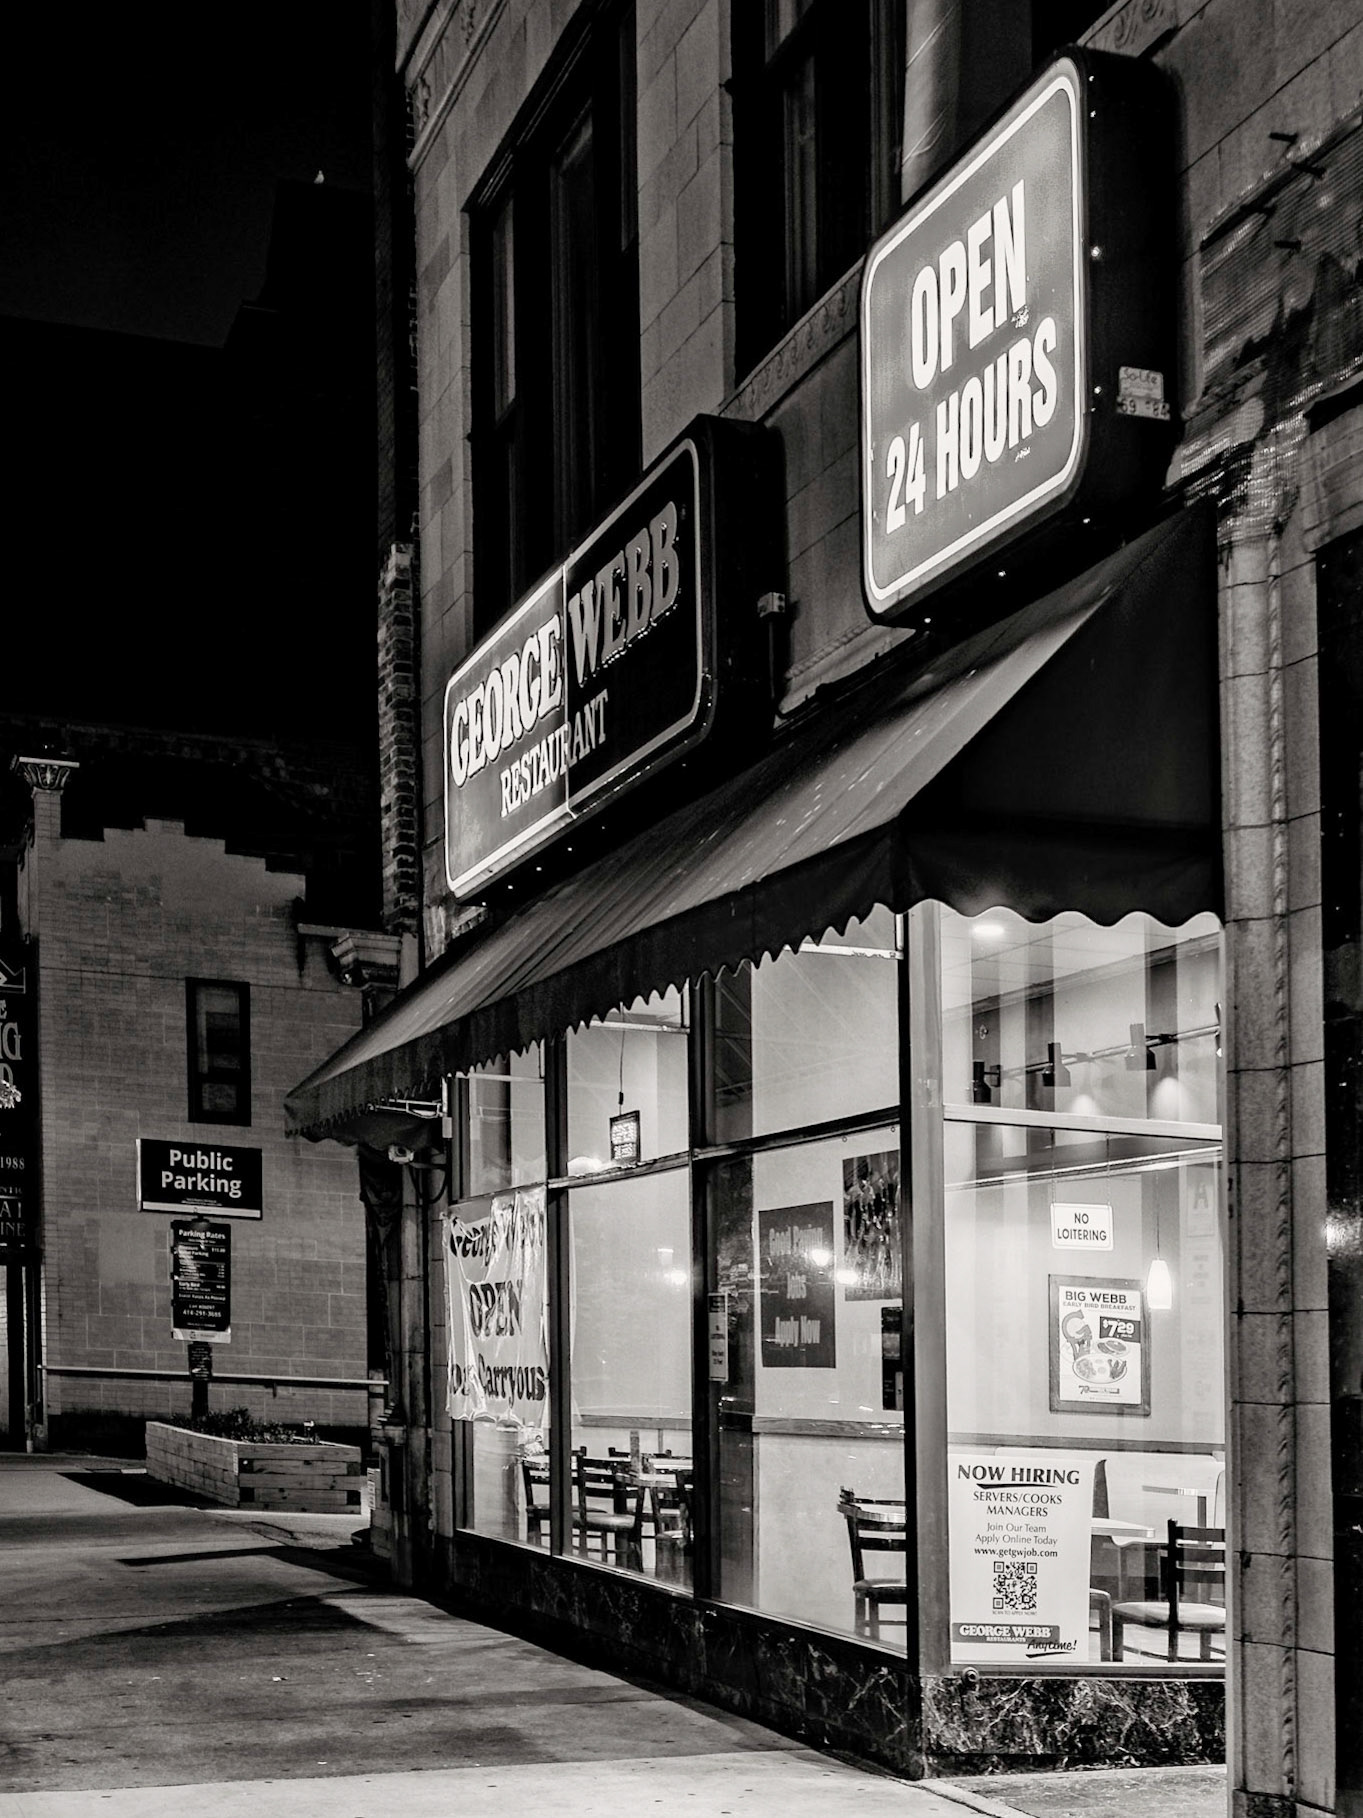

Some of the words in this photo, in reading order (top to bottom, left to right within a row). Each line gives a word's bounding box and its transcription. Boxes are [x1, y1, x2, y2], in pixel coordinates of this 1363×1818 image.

[911, 179, 1026, 390] OPEN
[885, 422, 927, 535] 24
[935, 317, 1058, 501] HOURS
[450, 614, 563, 788] GEORGE
[567, 501, 680, 688] WEBB
[500, 689, 608, 818] RESTAURANT
[0, 1156, 25, 1170] 1988
[169, 1149, 233, 1171] Public
[161, 1171, 242, 1198] Parking
[1074, 1213, 1090, 1225] NO
[178, 1229, 205, 1240] Parking
[206, 1231, 226, 1240] Rates
[1057, 1228, 1108, 1241] LOITERING
[1065, 1291, 1086, 1302] BIG
[1090, 1292, 1127, 1304] WEBB
[469, 1279, 524, 1338] OPEN
[957, 1464, 1005, 1481] NOW
[1011, 1467, 1080, 1485] HIRING
[972, 1491, 1063, 1505] SERVERS/COOKS
[986, 1505, 1049, 1517] MANAGERS
[986, 1522, 1004, 1532] Join
[1006, 1523, 1023, 1532] Our
[1024, 1524, 1047, 1533] Team
[975, 1533, 1000, 1545] Apply
[1002, 1534, 1032, 1544] Online
[1033, 1535, 1058, 1547] Today
[974, 1547, 1058, 1559] www.getgwjob.com
[959, 1624, 1011, 1637] GEORGE
[1011, 1625, 1051, 1638] WEBB
[1027, 1638, 1077, 1652] Anytime!
